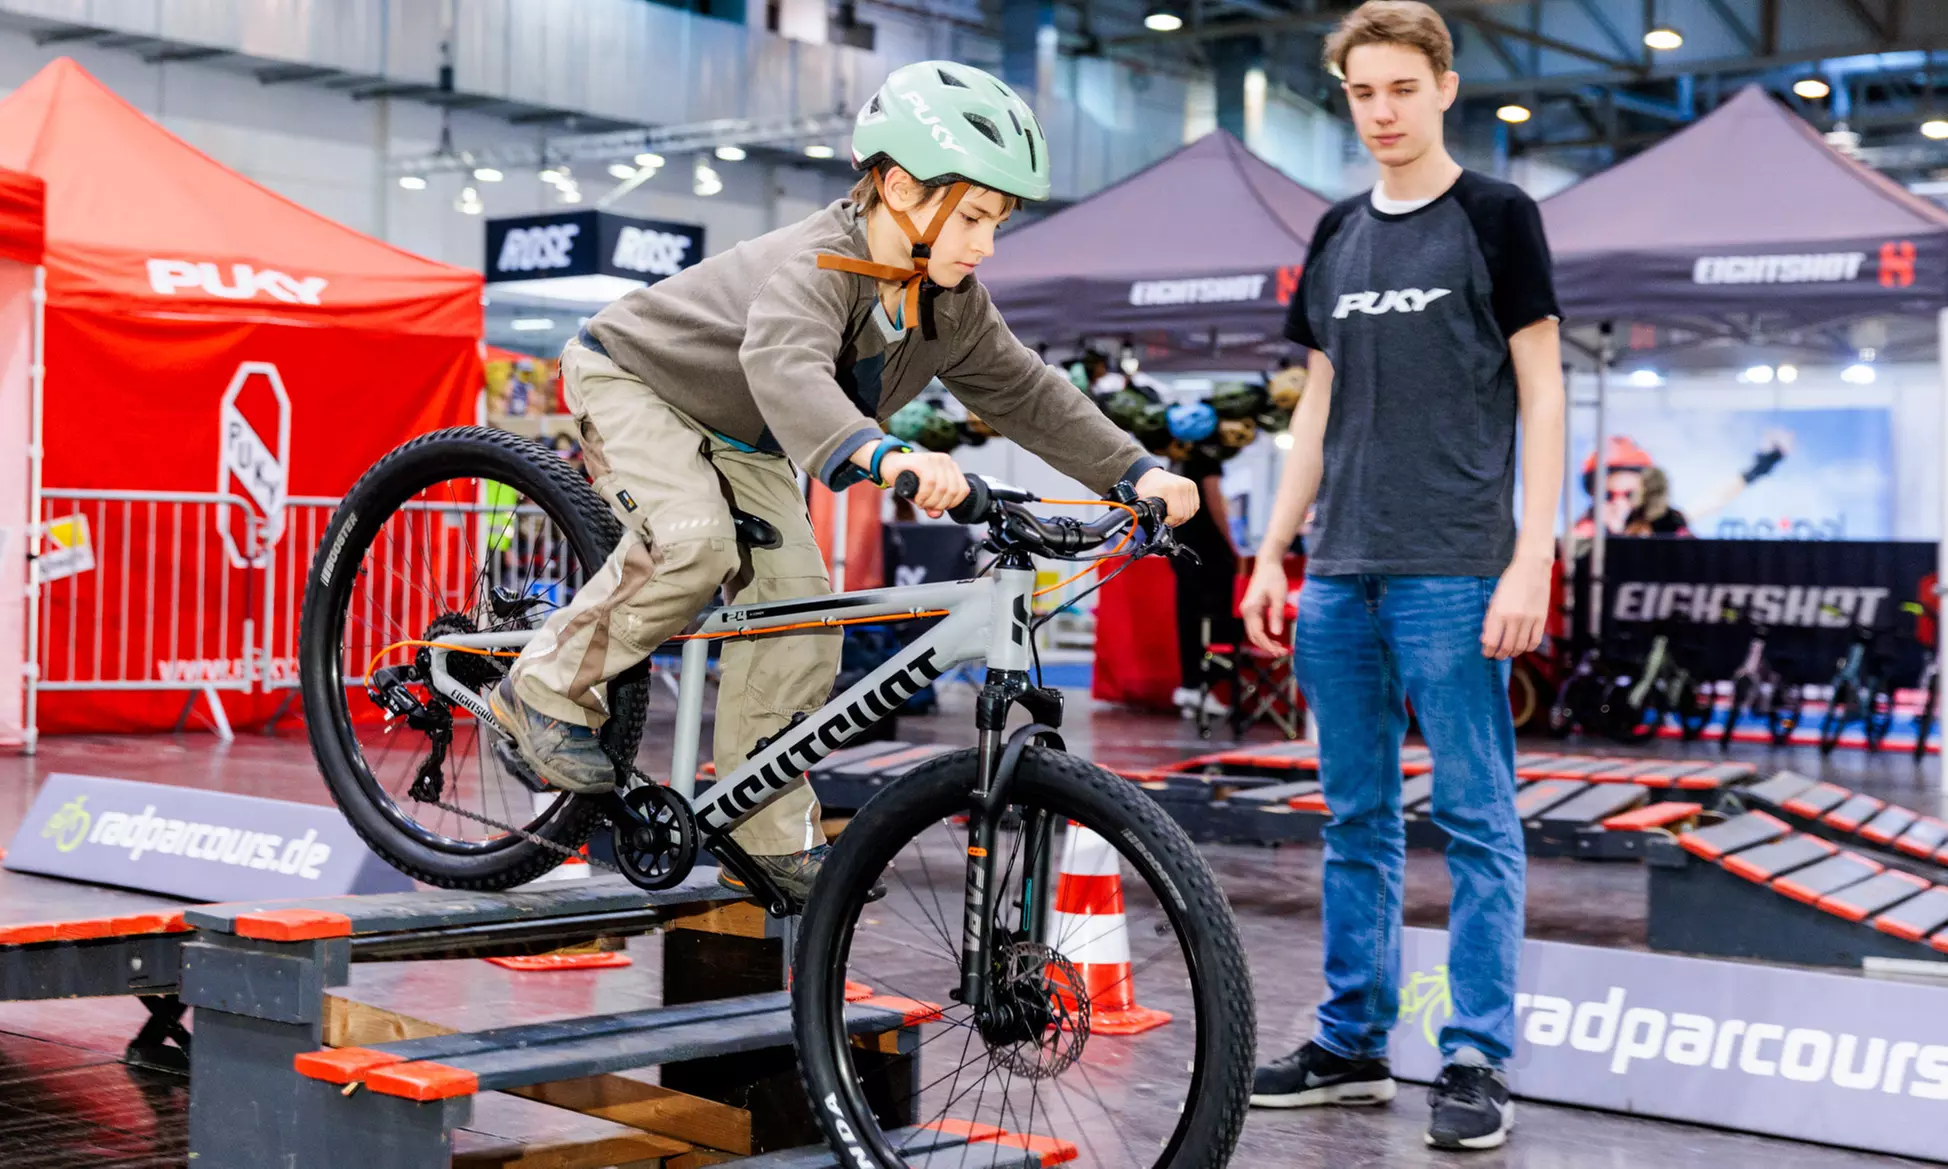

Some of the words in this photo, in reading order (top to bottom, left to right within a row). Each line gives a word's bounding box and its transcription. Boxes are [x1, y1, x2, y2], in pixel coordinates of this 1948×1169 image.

[901, 90, 970, 156] PUKY
[497, 223, 580, 272] ROSE
[612, 226, 692, 276] ROSE
[1693, 252, 1866, 284] EIGHTSHOT
[147, 258, 329, 305] PUKY
[1332, 287, 1452, 319] PUKY
[1612, 582, 1890, 628] EIGHTSHOT
[88, 804, 332, 880] radparcours.de
